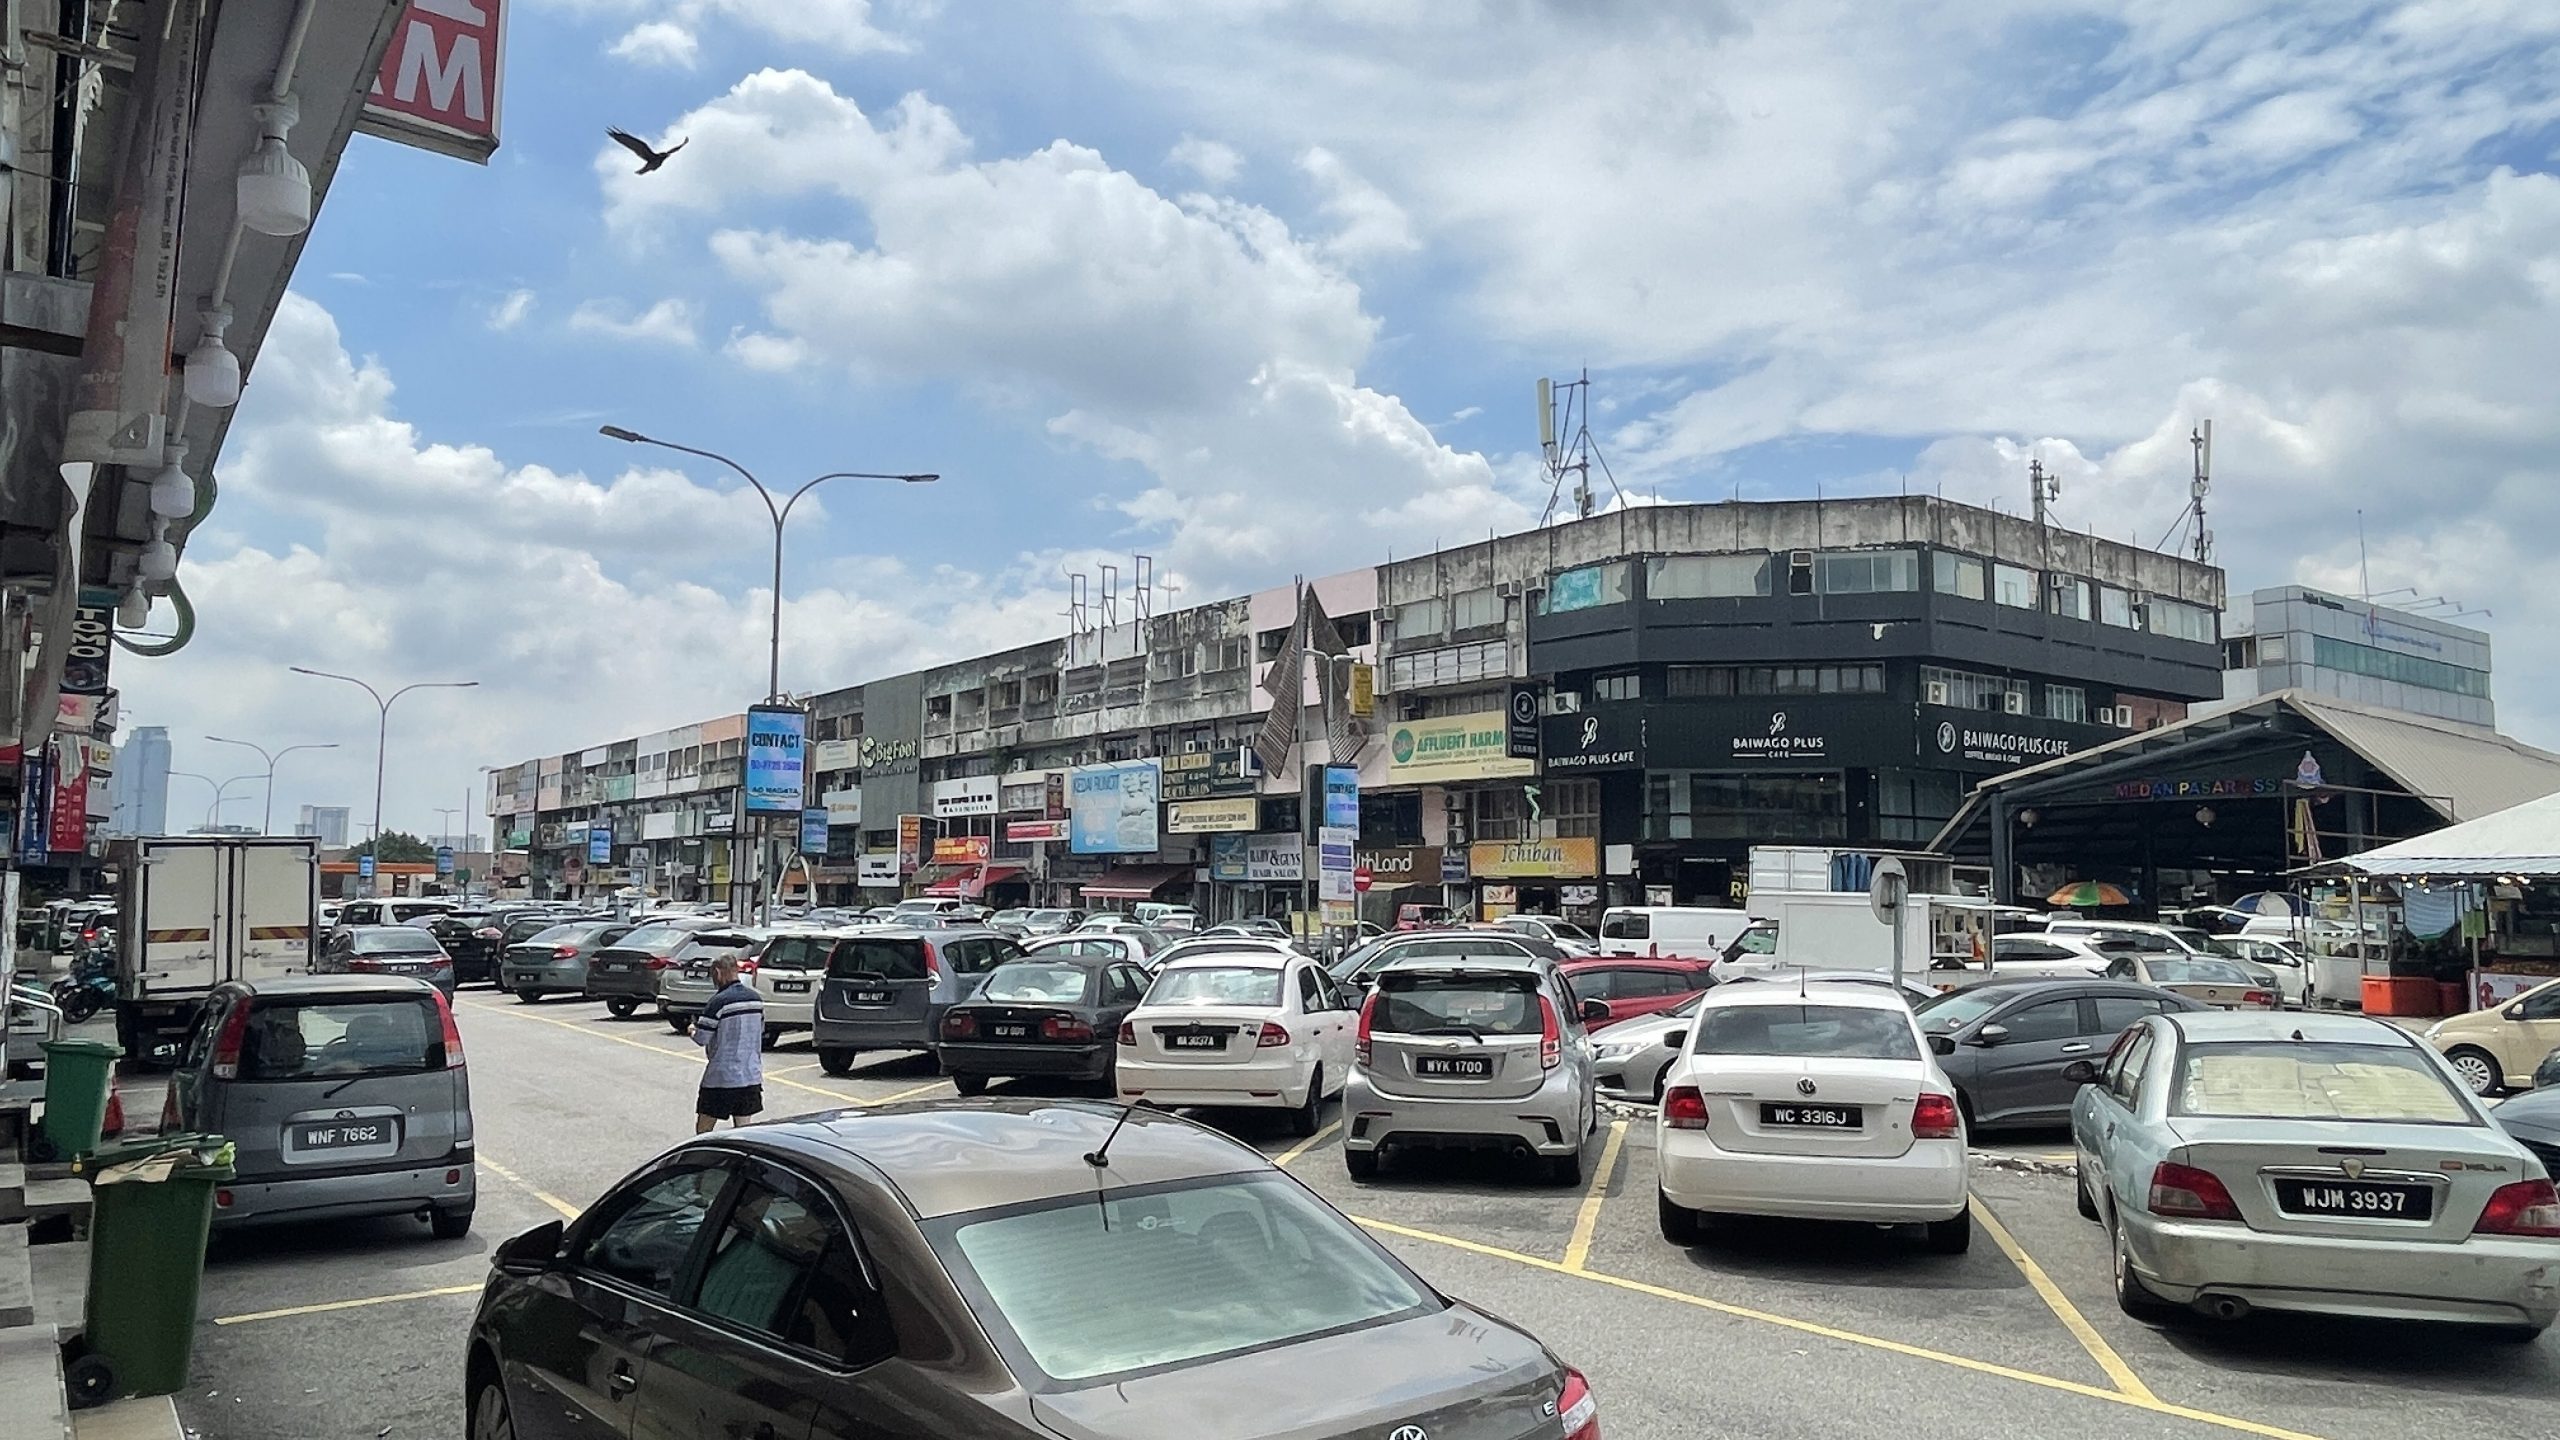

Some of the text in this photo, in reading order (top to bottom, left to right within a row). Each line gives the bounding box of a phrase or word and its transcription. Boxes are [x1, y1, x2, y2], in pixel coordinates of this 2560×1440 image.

[752, 732, 801, 748] CONTACT
[1416, 733, 1467, 752] AFFLUENT
[1470, 730, 1505, 748] HARM
[1733, 737, 1824, 749] BAIWAGO PLUS
[1964, 730, 2069, 756] BAIWAGO PLUS CAFE
[876, 740, 916, 767] BigFoot
[1588, 751, 1610, 765] PLUS
[1611, 750, 1635, 763] CAFE
[2115, 782, 2174, 798] MEDAN
[2179, 780, 2236, 796] PASAR
[1279, 853, 1301, 866] GUYS
[1501, 843, 1563, 863] Ichiban
[1273, 868, 1298, 878] SALON
[1426, 1059, 1482, 1074] WYK 1700
[1774, 1108, 1847, 1125] WC 3316J
[307, 1126, 378, 1145] WNF 7662
[2303, 1187, 2407, 1212] WJM 3937
